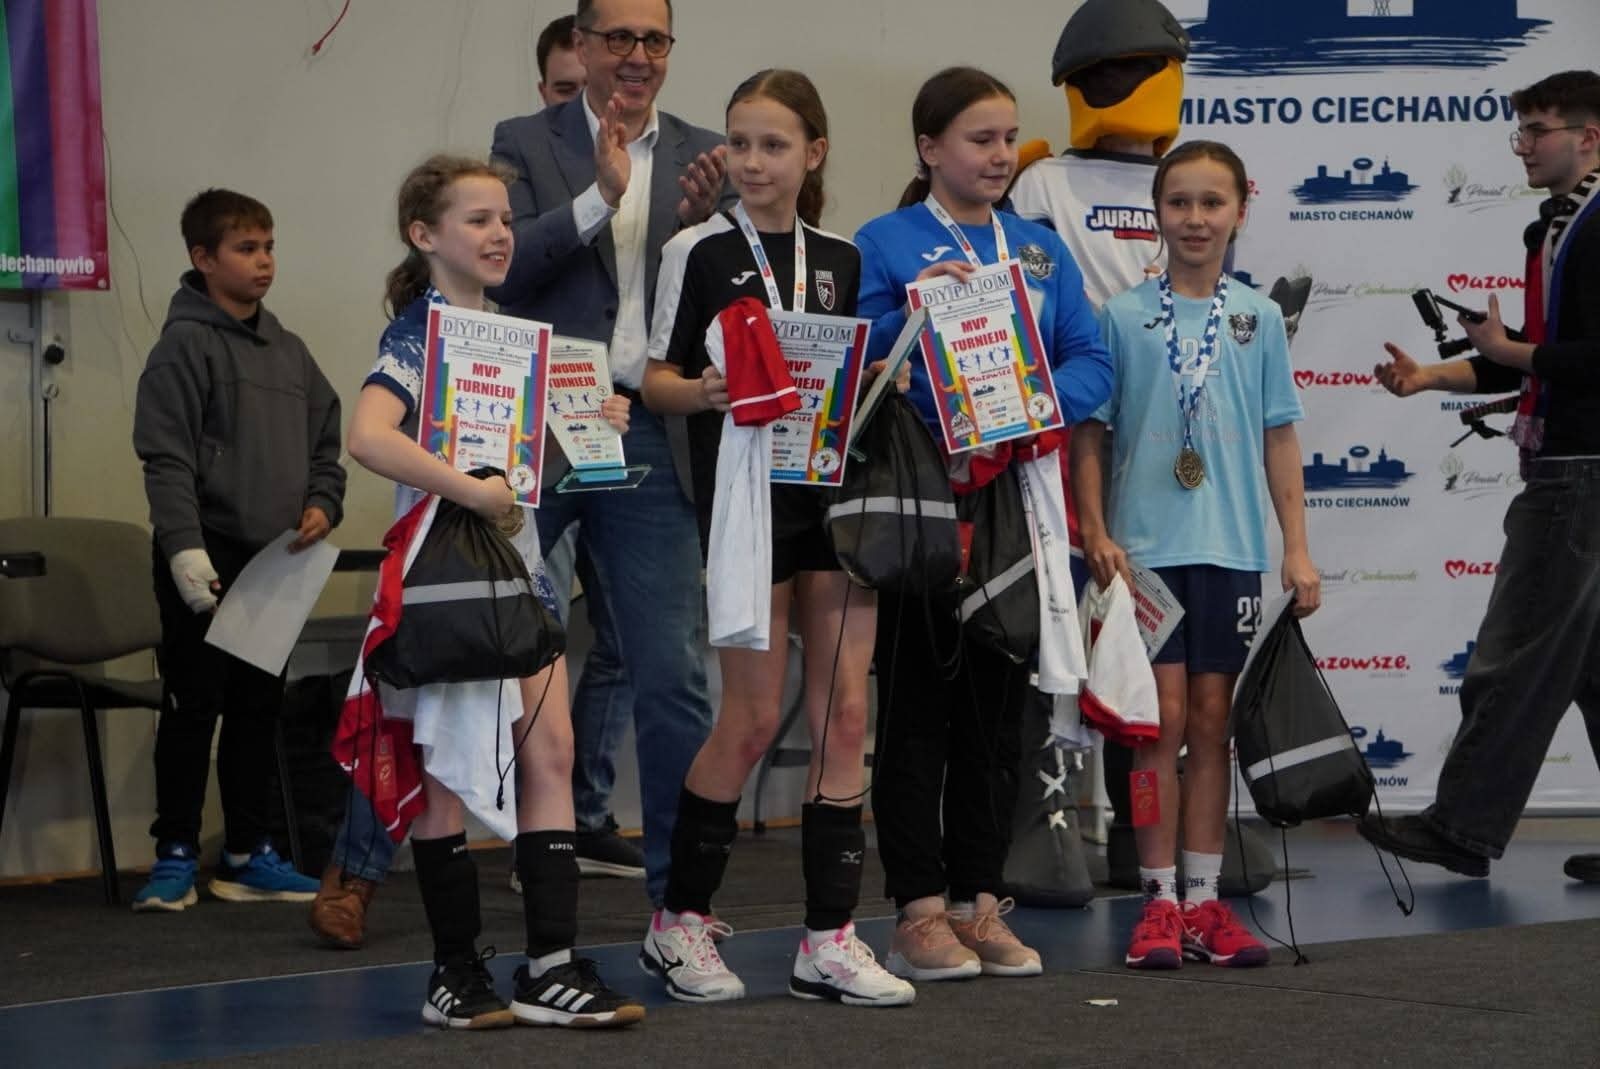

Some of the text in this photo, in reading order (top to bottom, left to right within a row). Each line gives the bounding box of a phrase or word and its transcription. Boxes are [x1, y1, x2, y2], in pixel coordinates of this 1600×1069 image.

[1090, 209, 1159, 231] JURAN
[1289, 208, 1414, 221] MIASTO CIECHANÓW
[0, 253, 95, 274] iechanowie
[923, 274, 1010, 305] DYPLOM
[443, 319, 535, 347] DYPLOM
[773, 321, 852, 341] YPLOM
[961, 316, 989, 334] MVP
[950, 329, 1009, 353] TURNIEJU
[472, 362, 502, 379] MVP
[550, 362, 596, 374] WODNIK
[455, 378, 517, 400] TURNIEJU
[1293, 370, 1383, 390] Mazow
[1335, 495, 1411, 508] CIECHANÓW
[1313, 653, 1410, 671] azowsze.
